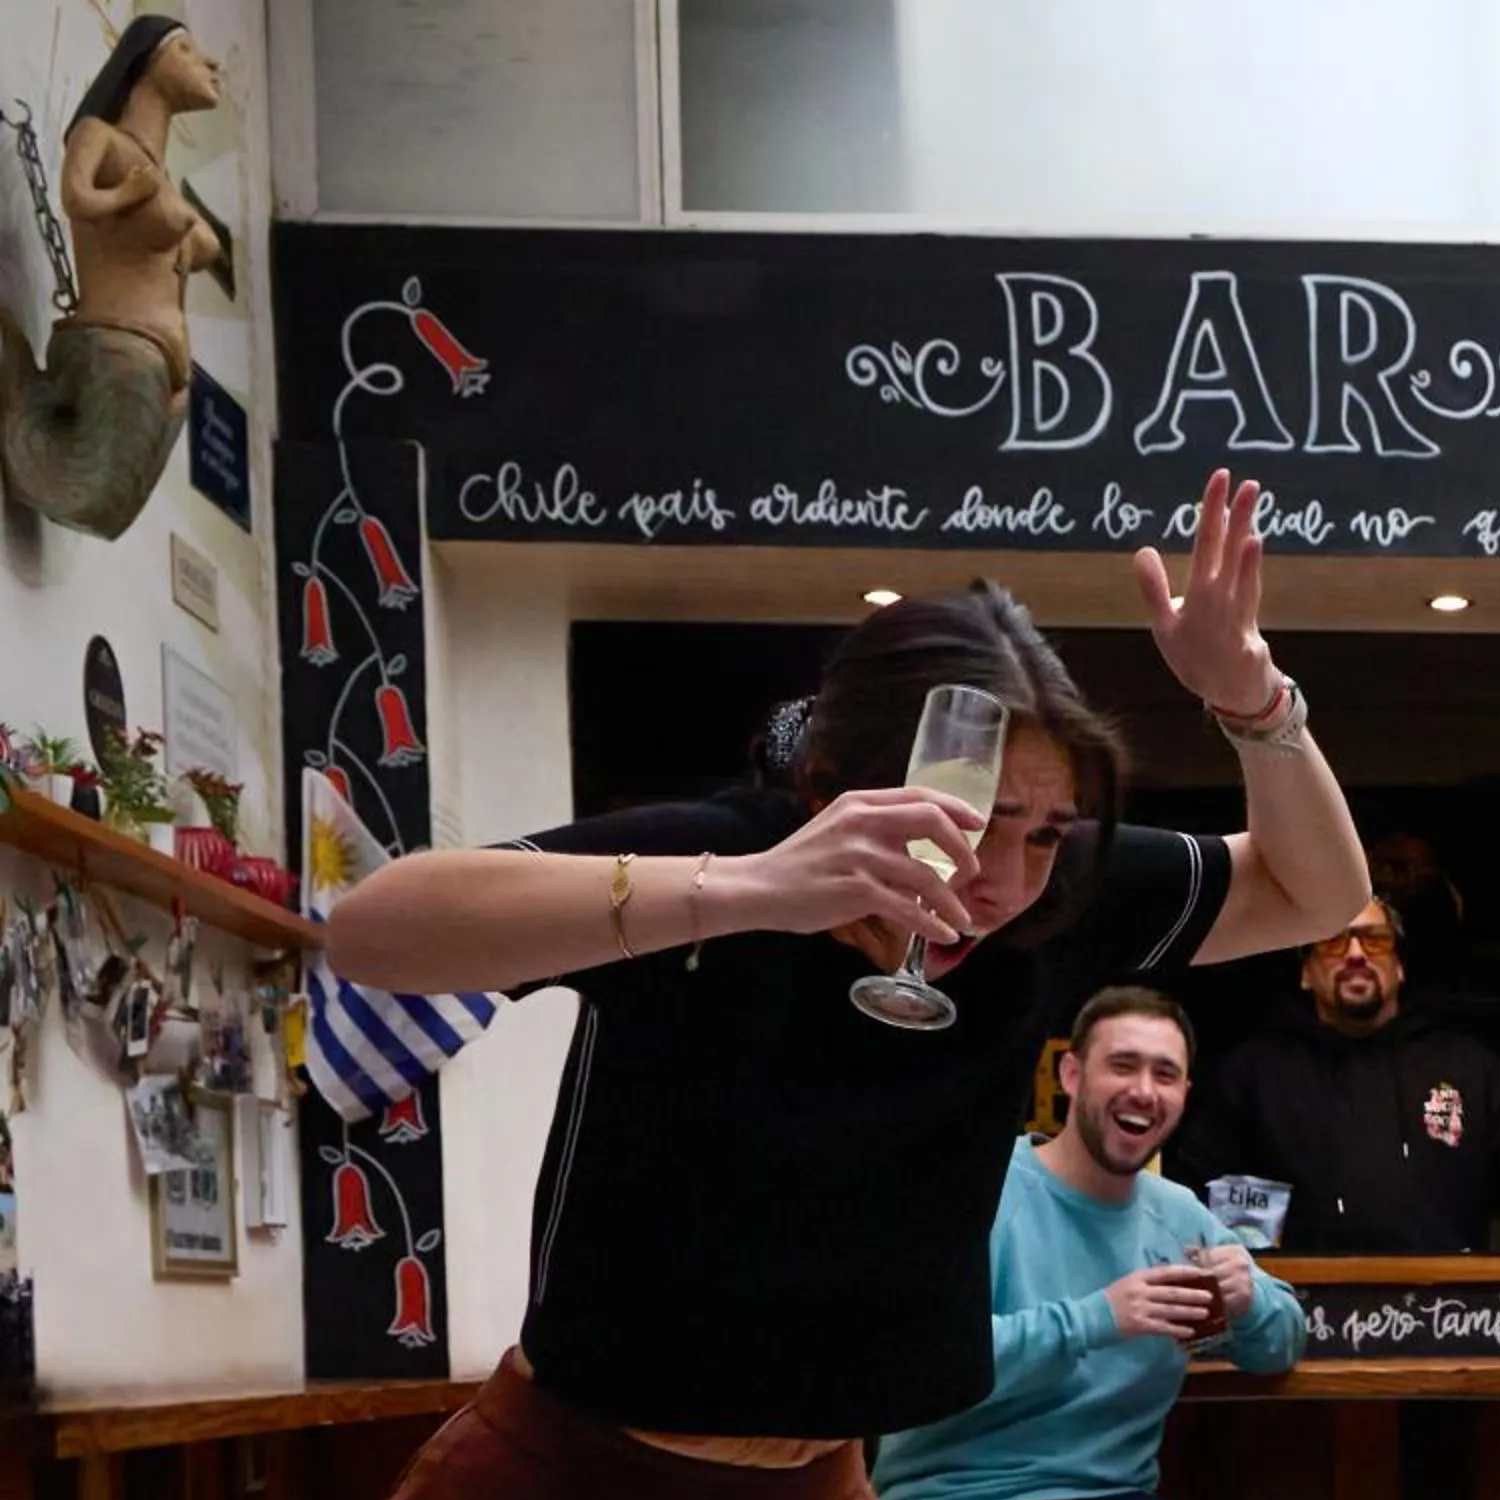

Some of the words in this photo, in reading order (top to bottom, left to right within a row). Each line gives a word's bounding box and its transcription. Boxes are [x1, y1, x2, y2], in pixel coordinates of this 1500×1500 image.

[995, 270, 1442, 456] BAR
[459, 461, 607, 526] Chile
[750, 479, 930, 532] ardiente
[940, 485, 1076, 535] donde
[1092, 481, 1155, 540] lo
[1350, 504, 1436, 546] no
[1229, 1185, 1268, 1209] tika
[1342, 1304, 1424, 1352] pero
